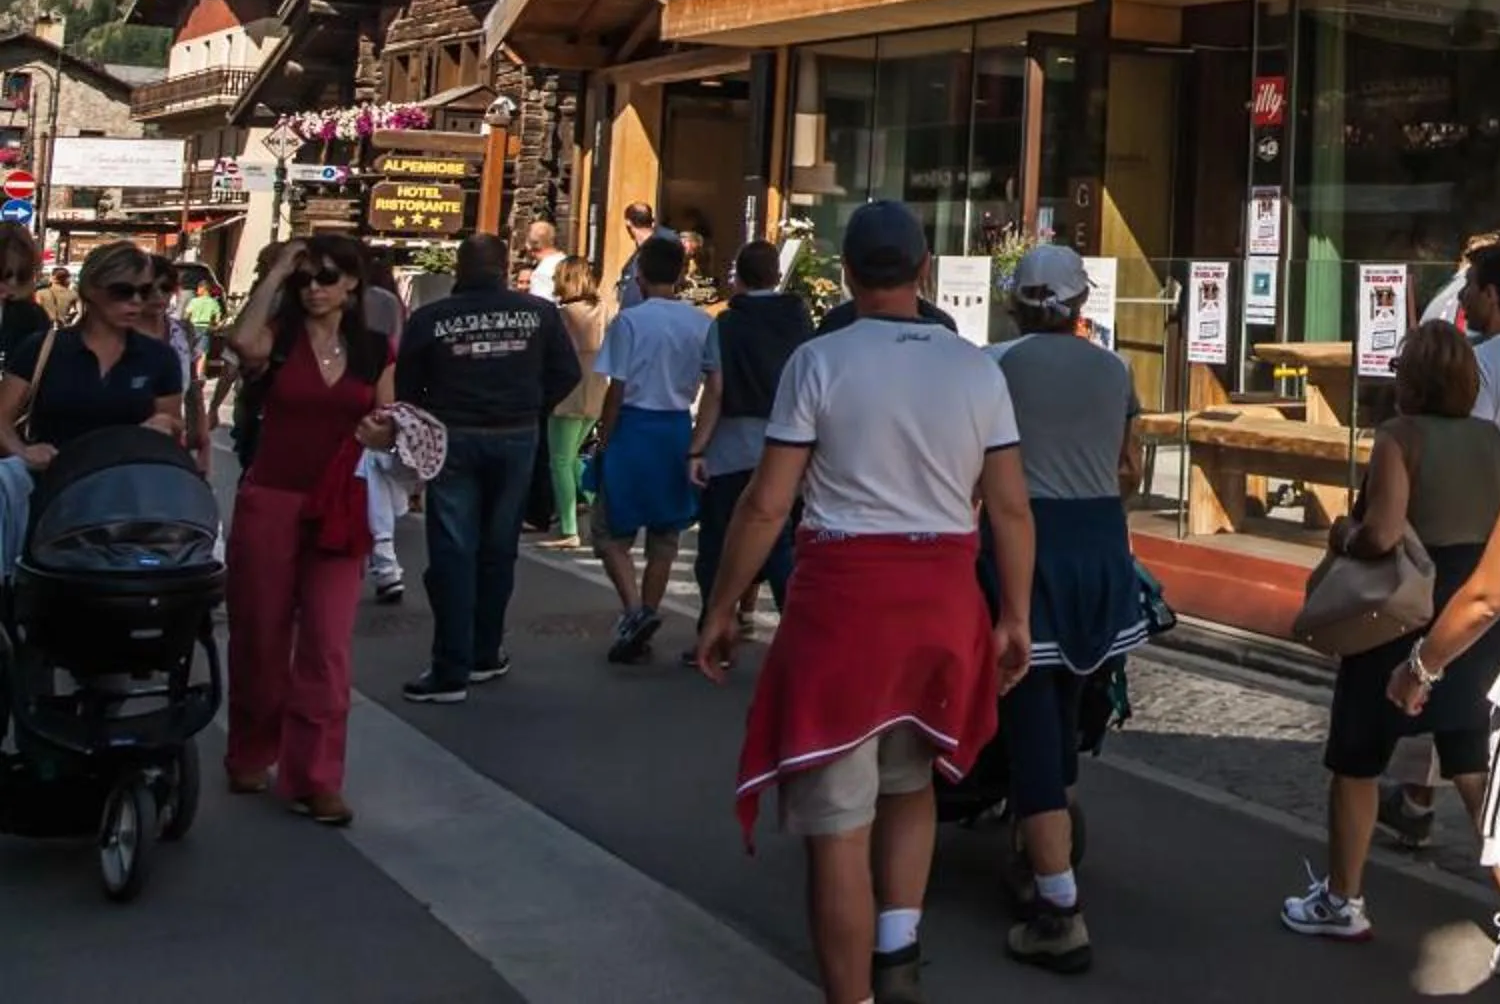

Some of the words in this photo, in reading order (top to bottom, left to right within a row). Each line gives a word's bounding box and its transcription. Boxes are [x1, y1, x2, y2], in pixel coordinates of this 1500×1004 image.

[1255, 83, 1283, 120] illy
[383, 159, 465, 175] ALPENROSE
[397, 185, 442, 199] HOTEL
[375, 197, 461, 213] RISTORANTE
